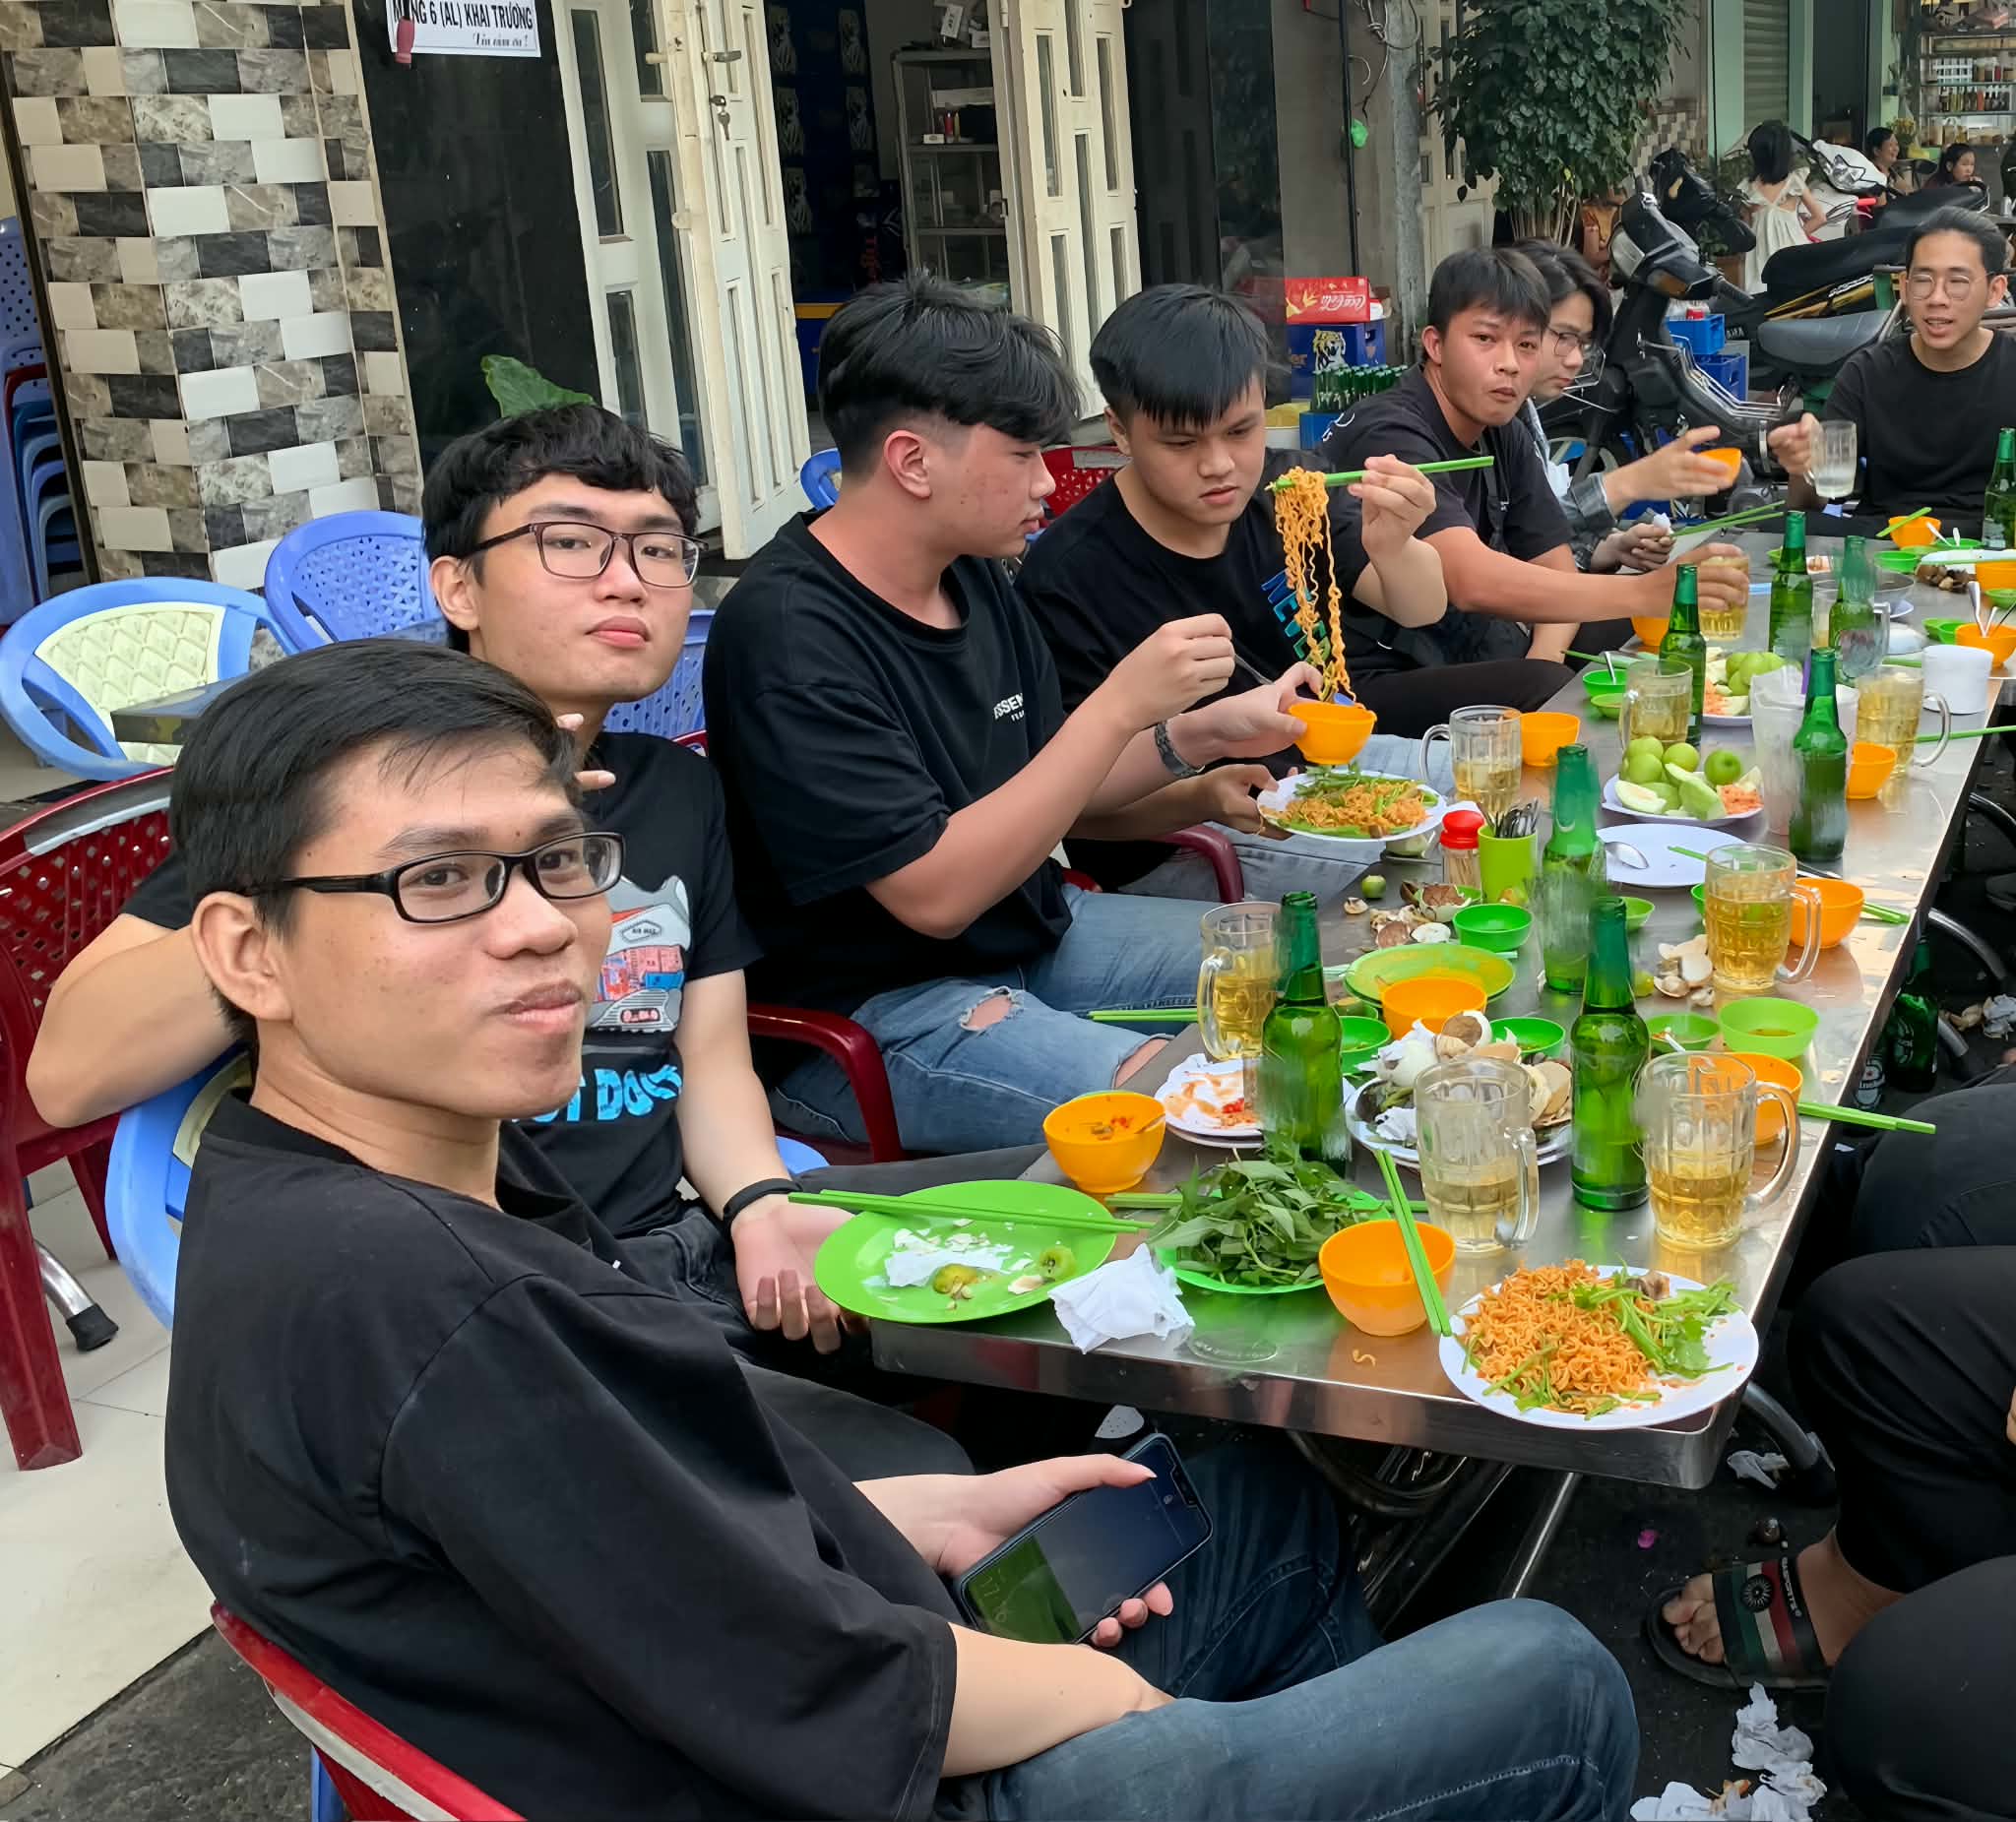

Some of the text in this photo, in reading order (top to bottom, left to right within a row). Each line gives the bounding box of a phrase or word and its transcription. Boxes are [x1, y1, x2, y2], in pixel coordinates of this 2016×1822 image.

[392, 0, 427, 24] MNG
[429, 1, 437, 25] 6
[439, 1, 464, 29] (AL)
[464, 3, 490, 28] KHAI
